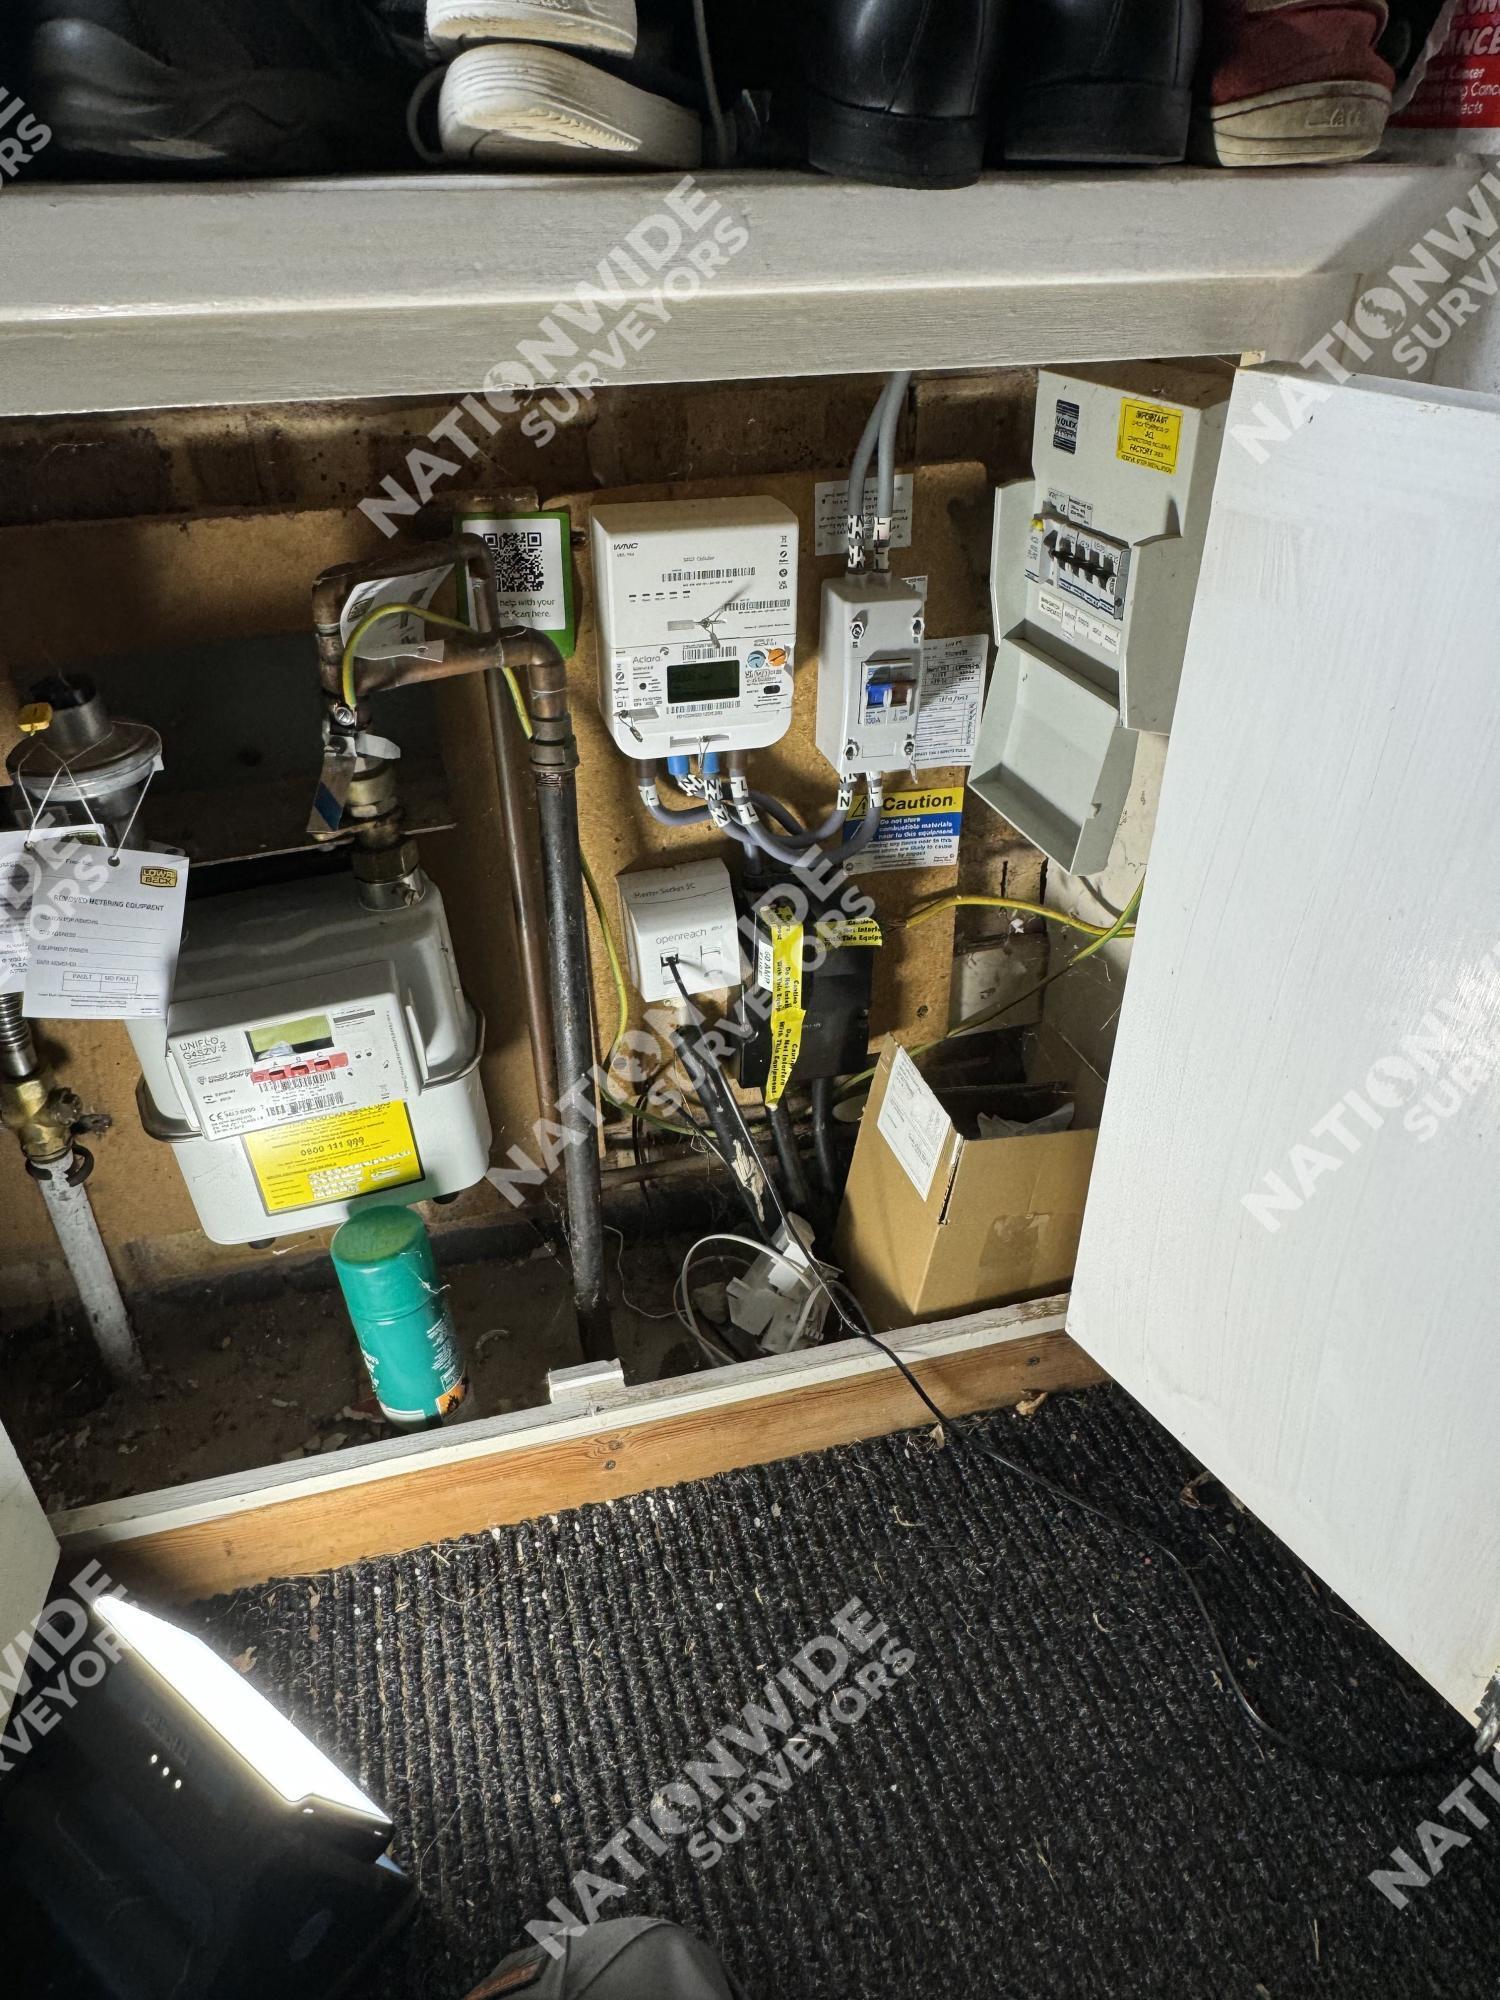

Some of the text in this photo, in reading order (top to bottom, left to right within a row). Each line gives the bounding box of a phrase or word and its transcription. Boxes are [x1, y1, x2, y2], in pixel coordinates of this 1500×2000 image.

[518, 598, 536, 606] with
[537, 599, 556, 607] your
[633, 655, 661, 663] Aclara
[840, 796, 850, 807] N
[882, 795, 953, 811] Caution
[89, 898, 124, 907] METERING
[126, 901, 164, 911] EQUIPMENT
[656, 929, 707, 944] openreach
[180, 1037, 219, 1051] UNIFLO
[301, 1136, 365, 1156] 0800 111 999
